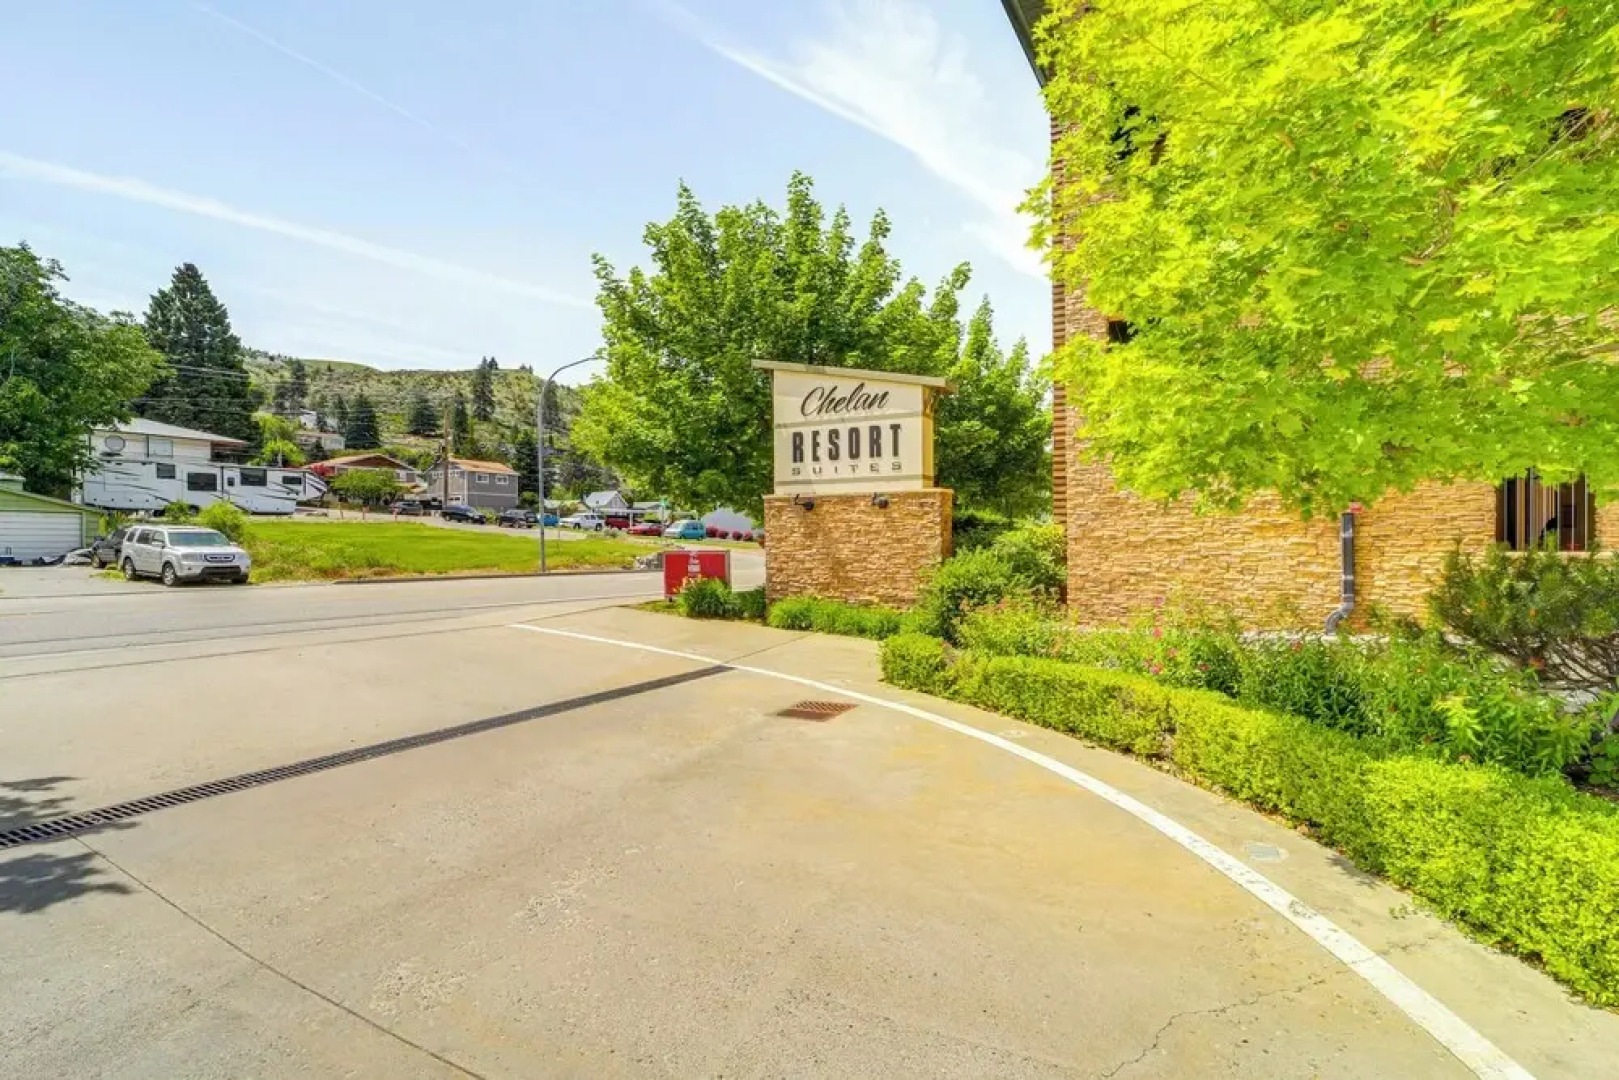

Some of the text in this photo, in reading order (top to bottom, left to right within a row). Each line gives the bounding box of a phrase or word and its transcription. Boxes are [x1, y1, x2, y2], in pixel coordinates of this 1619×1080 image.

[801, 383, 890, 417] Chelan
[792, 424, 901, 463] RESORT
[791, 463, 902, 476] SUITES
